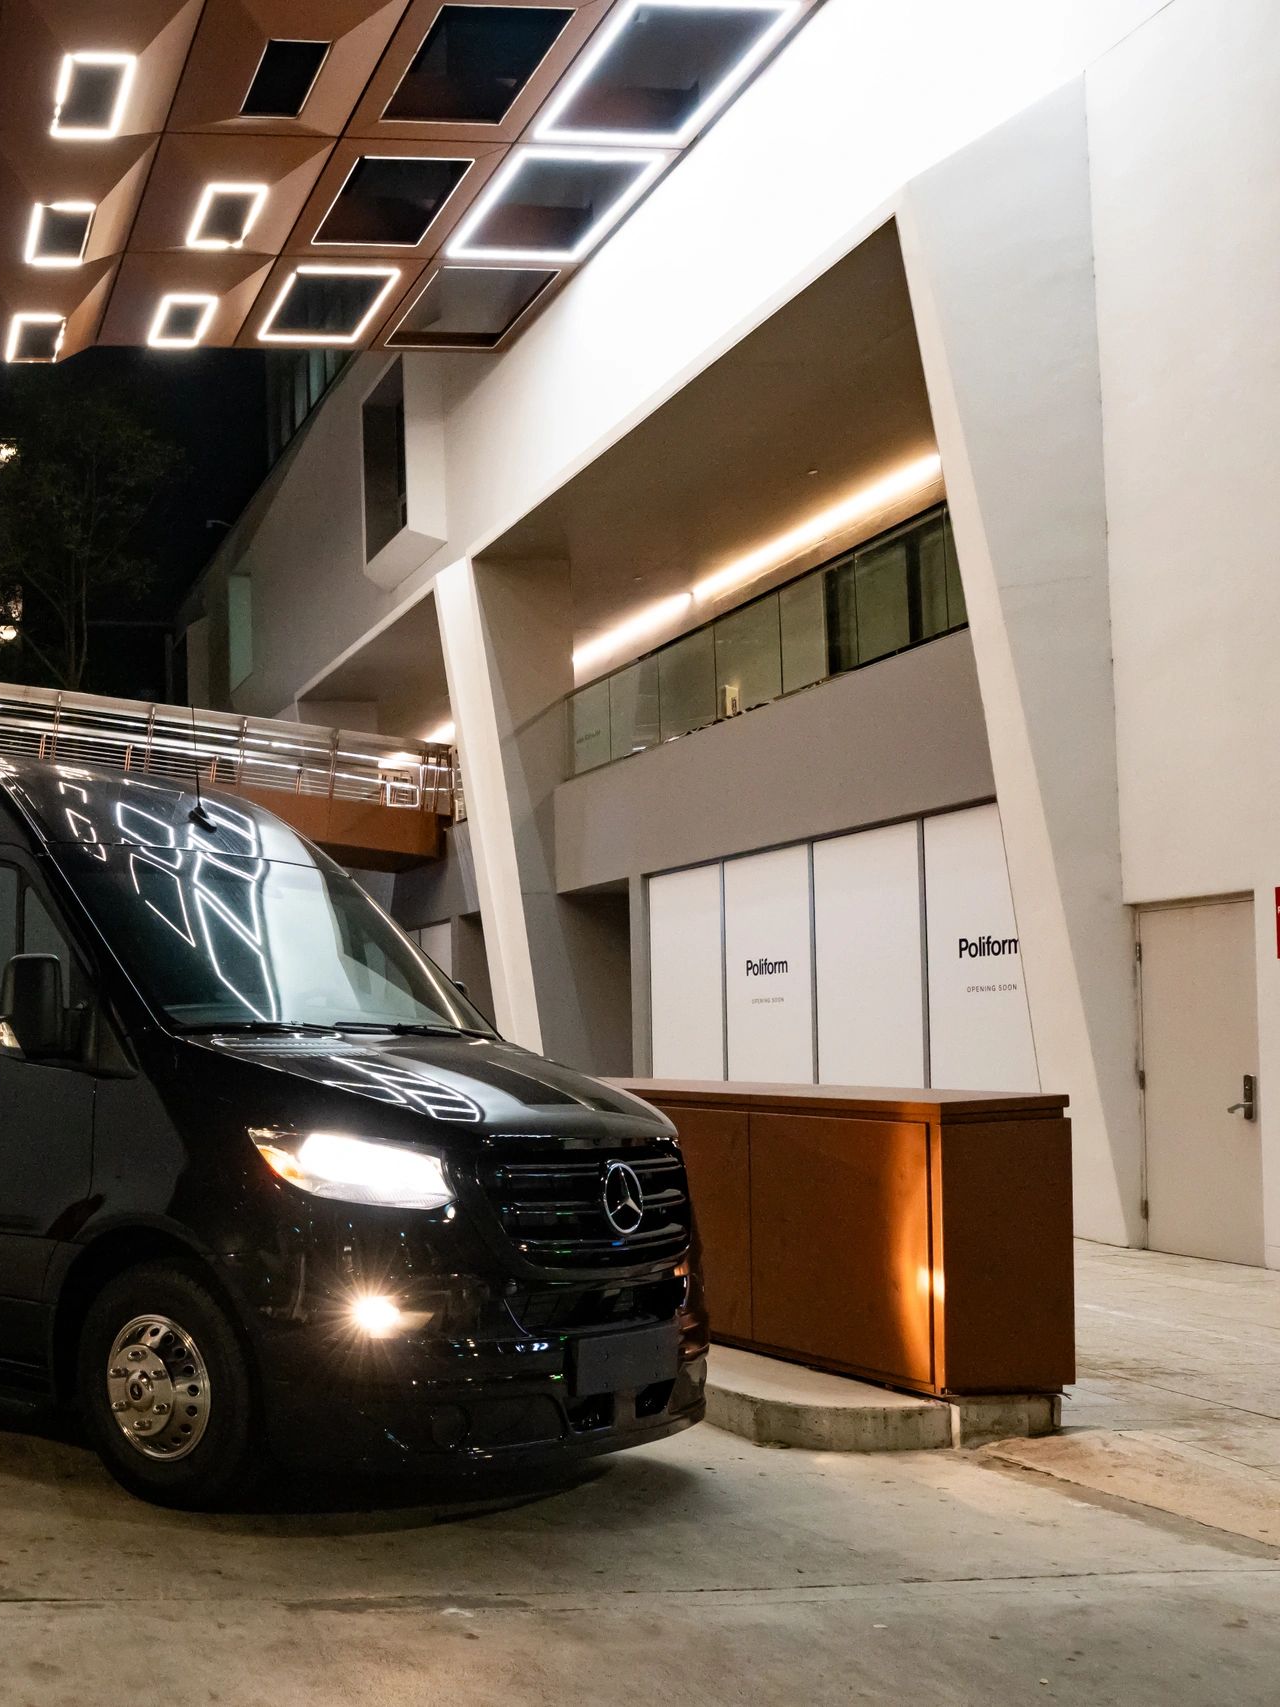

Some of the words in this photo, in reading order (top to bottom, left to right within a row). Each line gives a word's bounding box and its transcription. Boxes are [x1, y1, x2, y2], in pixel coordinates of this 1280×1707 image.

[746, 958, 788, 976] Poliform
[967, 985, 996, 993] OPENING
[998, 984, 1018, 992] SOON
